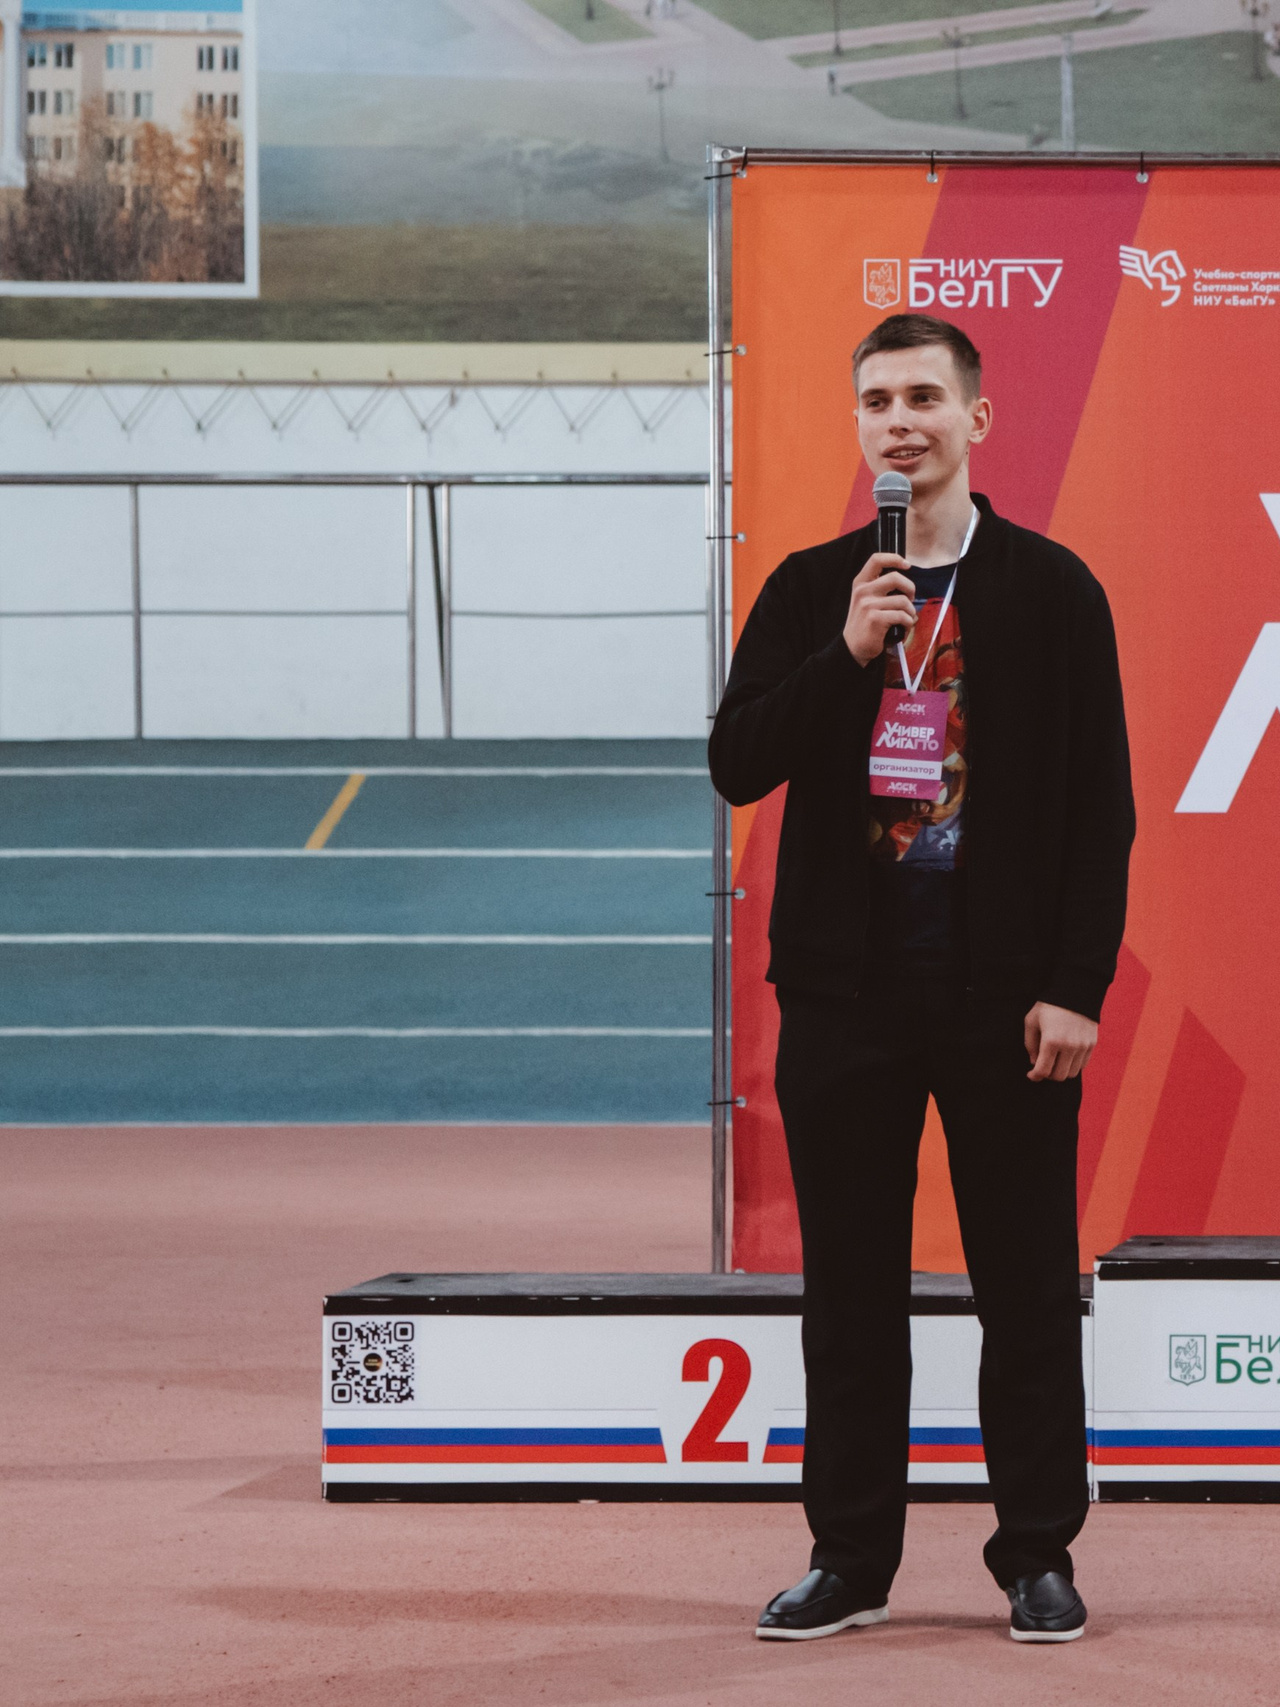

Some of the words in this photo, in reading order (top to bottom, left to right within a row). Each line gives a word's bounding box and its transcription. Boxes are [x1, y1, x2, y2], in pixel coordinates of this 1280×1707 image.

[940, 259, 992, 278] НИУ
[909, 266, 1063, 307] БелГУ
[1193, 281, 1249, 292] Светланы
[1194, 295, 1222, 306] НИУ
[873, 763, 935, 775] организатор
[681, 1338, 752, 1463] 2
